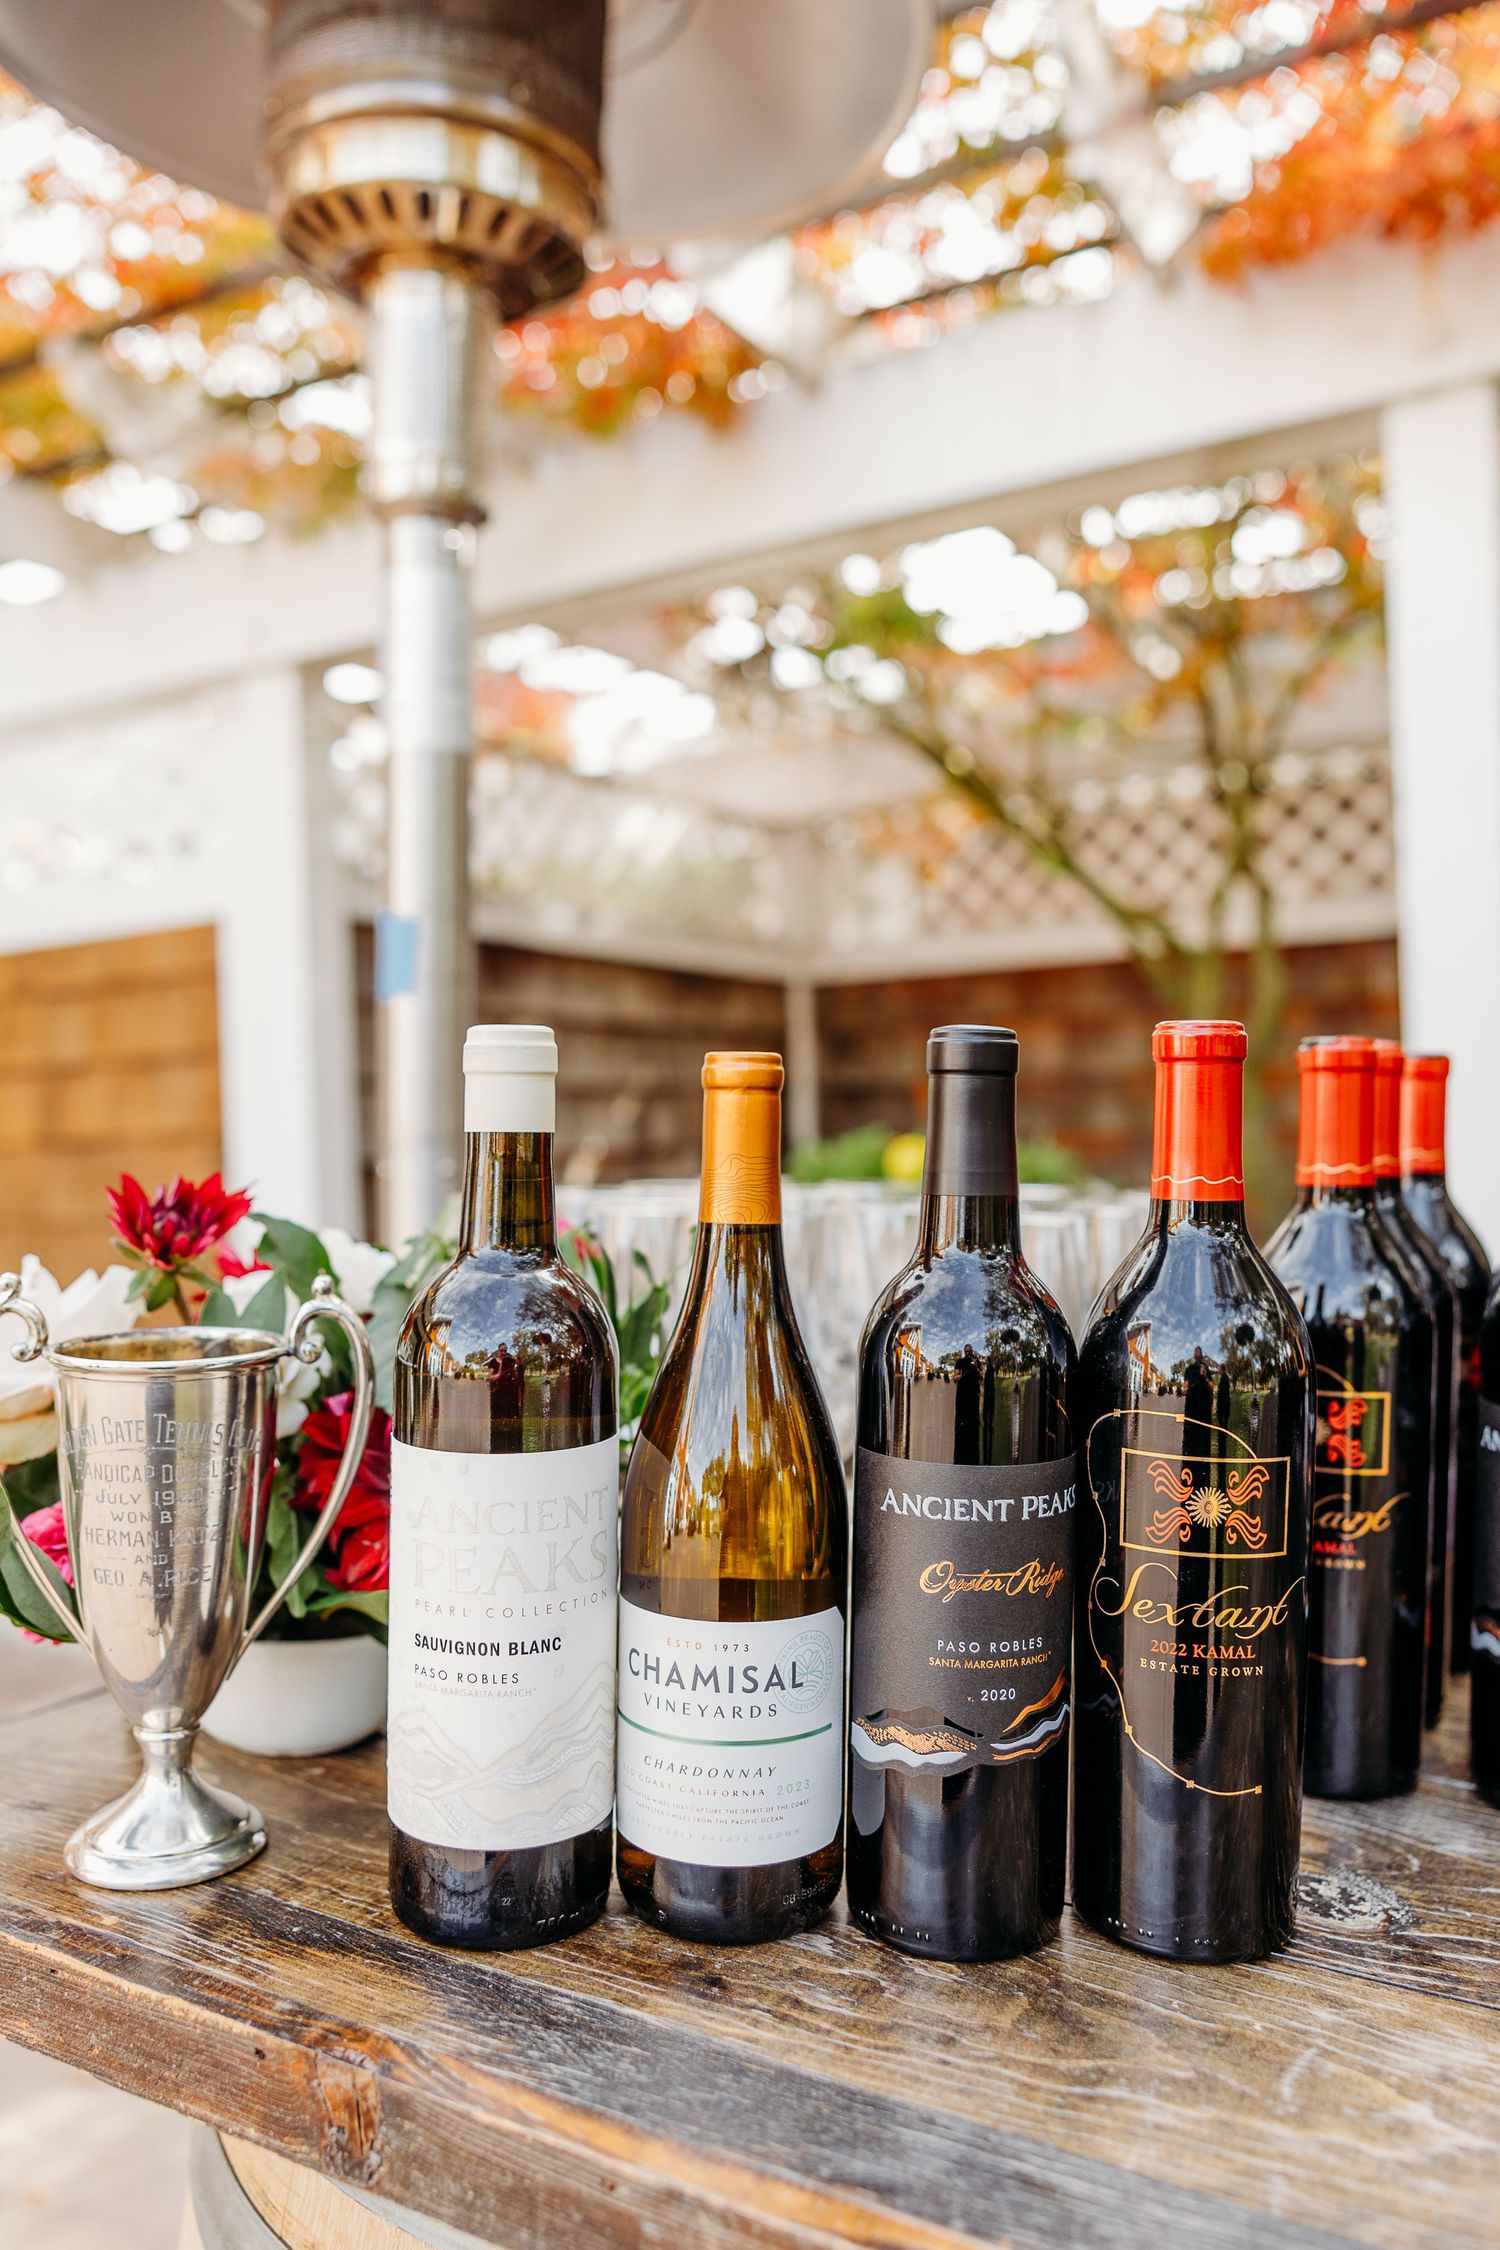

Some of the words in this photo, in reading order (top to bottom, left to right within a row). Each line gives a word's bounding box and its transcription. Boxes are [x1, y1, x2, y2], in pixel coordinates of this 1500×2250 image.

[101, 1416, 145, 1446] GATE
[153, 1413, 225, 1446] TENNIS
[76, 1462, 156, 1484] HANDICAP
[96, 1489, 143, 1505] JULY
[881, 1488, 1014, 1522] ANCIENT
[1021, 1483, 1077, 1521] PEAKS
[110, 1510, 152, 1523] WON
[412, 1487, 608, 1535] ANCIENT
[85, 1525, 160, 1548] HERMAN
[1313, 1540, 1356, 1555] AMAL
[134, 1553, 168, 1565] AND
[412, 1529, 609, 1595] PEAKS
[919, 1560, 1005, 1604] Oyster
[1006, 1557, 1065, 1600] Ridge
[415, 1598, 469, 1618] PEARL
[486, 1588, 608, 1619] COLLECTION
[1095, 1563, 1306, 1640] Sextant
[414, 1633, 501, 1657] SAUVIGNON
[508, 1636, 562, 1656] BLANC
[666, 1637, 702, 1651] ESTD
[713, 1643, 750, 1653] 1973
[937, 1639, 980, 1653] PASO
[989, 1636, 1043, 1653] ROBLES
[1150, 1639, 1188, 1657] 2022
[1192, 1643, 1256, 1659] KAMAL
[628, 1648, 804, 1694] CHAMISAL
[928, 1656, 962, 1669] SANTA
[963, 1656, 1019, 1669] MARGARITA
[1140, 1658, 1200, 1676] ESTATE
[1209, 1665, 1265, 1677] GROWN
[414, 1664, 448, 1682] PASO
[456, 1671, 520, 1685] ROBLES
[413, 1680, 440, 1693] SANTA
[440, 1685, 494, 1698] MARGARITA
[980, 1688, 1016, 1702] 2020
[643, 1692, 778, 1719] VINEYARDS
[644, 1754, 778, 1778] CHARDONNAY
[638, 1771, 673, 1791] COAST
[679, 1785, 766, 1797] CALIFORNIA
[777, 1778, 811, 1796] 2023
[691, 1806, 722, 1815] CAPTURE
[741, 1807, 763, 1815] SPIRIT
[777, 1803, 789, 1812] THE
[790, 1799, 811, 1809] COAST
[760, 1815, 785, 1824] OCEAN
